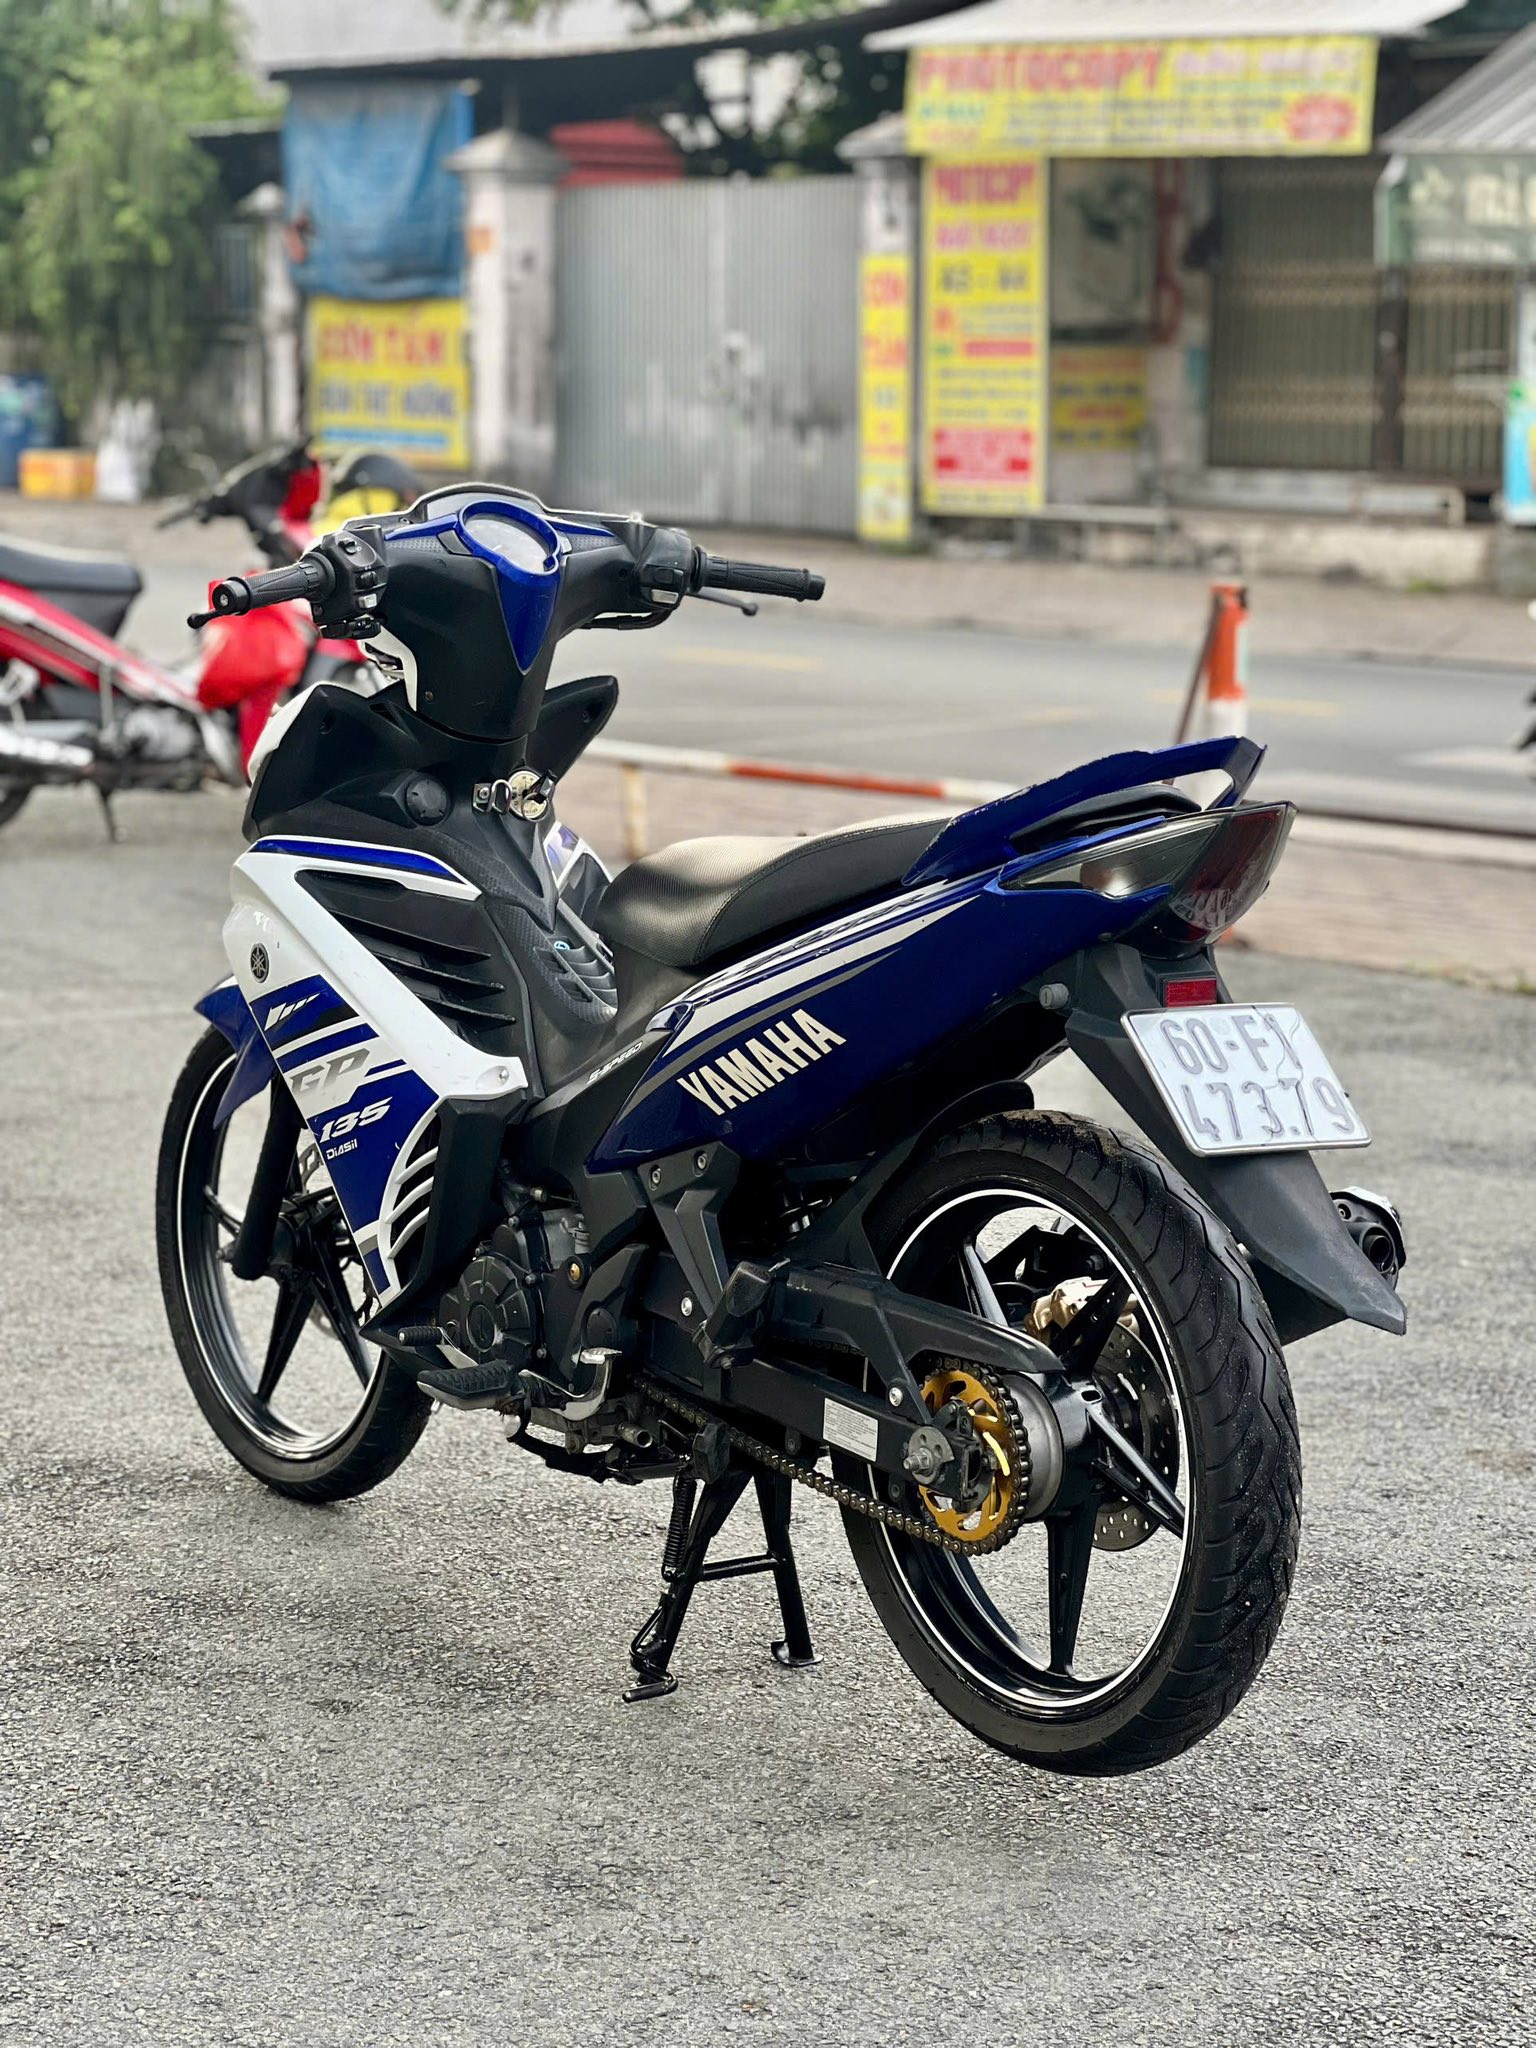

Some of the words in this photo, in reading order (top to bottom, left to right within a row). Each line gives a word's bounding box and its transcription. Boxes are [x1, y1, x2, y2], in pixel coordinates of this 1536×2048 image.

[917, 48, 1166, 93] PHOTOCOPY
[289, 1048, 371, 1093] GP
[676, 1008, 847, 1116] YAMAHA
[319, 1096, 393, 1144] 135
